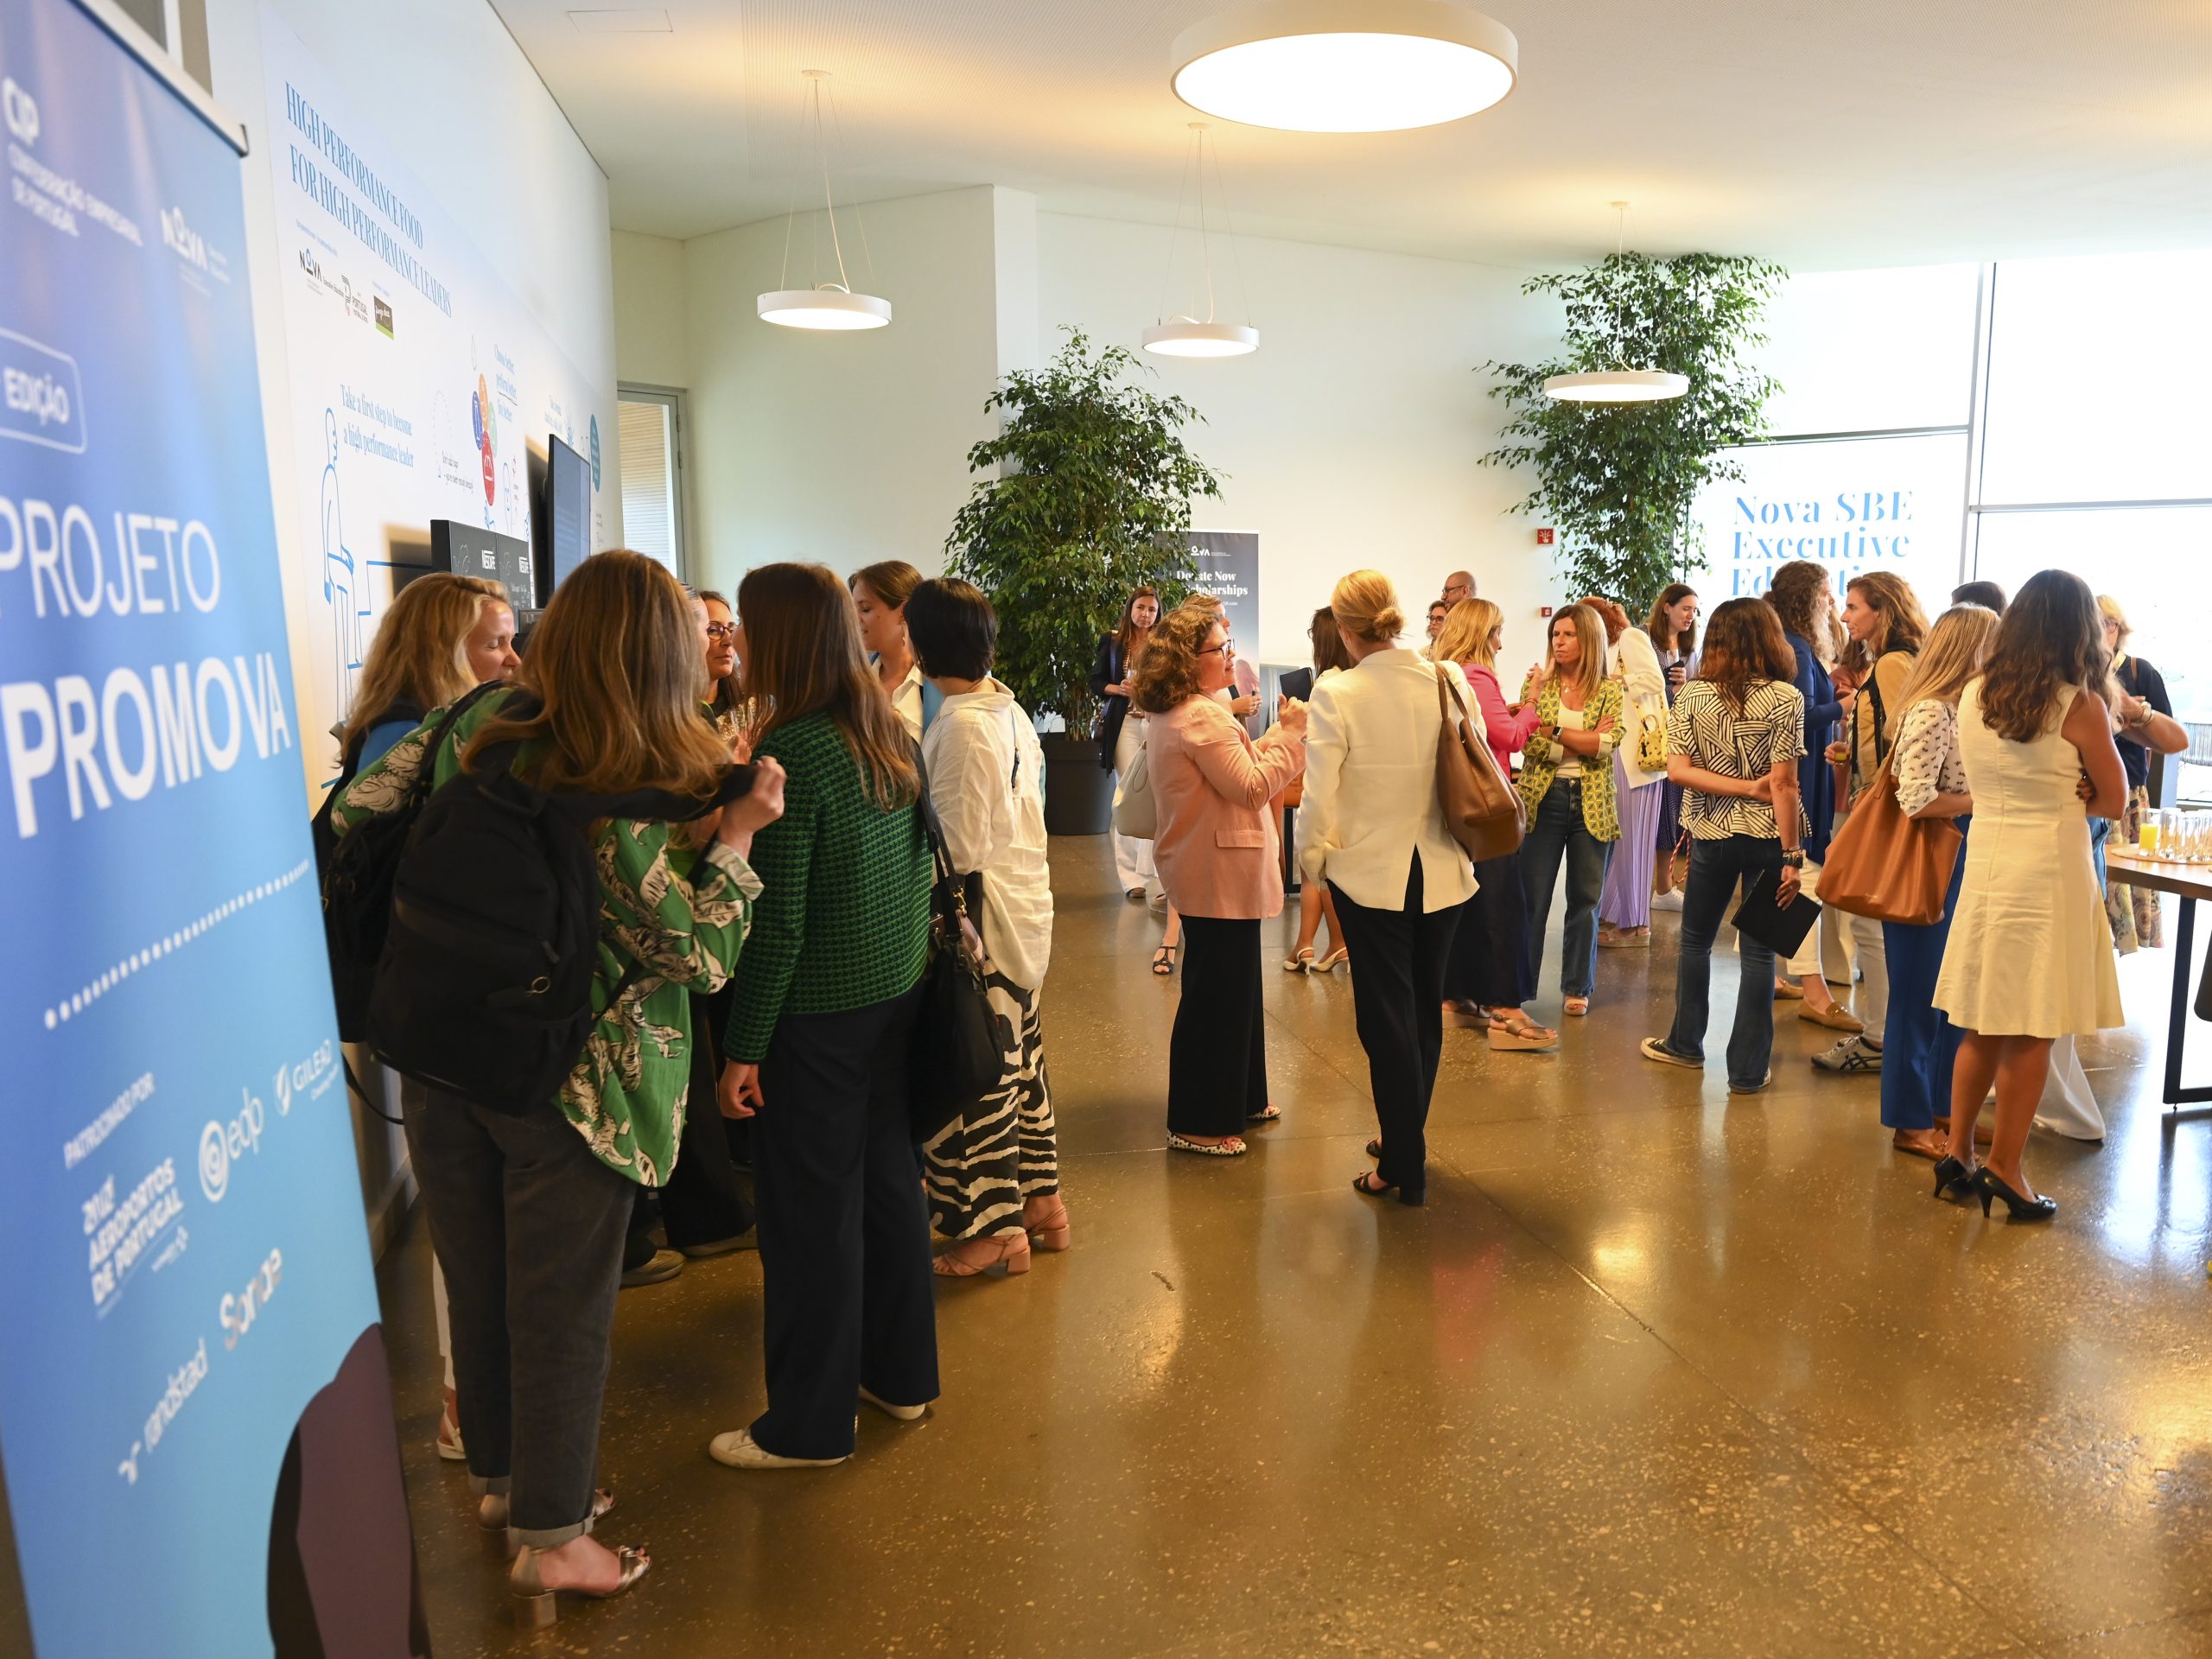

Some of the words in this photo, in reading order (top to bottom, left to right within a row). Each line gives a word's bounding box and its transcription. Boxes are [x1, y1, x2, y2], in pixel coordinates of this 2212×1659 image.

[285, 80, 321, 151] HIGH
[322, 119, 399, 228] PERFORMANCE
[398, 201, 423, 251] FOOD
[289, 143, 319, 203] FOR
[318, 170, 352, 232] HIGH
[351, 200, 421, 291] PERFORMANCE
[419, 264, 452, 319] LEADERS
[298, 247, 323, 283] NOVA
[340, 384, 357, 412] Take
[361, 392, 375, 421] first
[374, 403, 387, 429] step
[392, 408, 412, 436] become
[347, 422, 363, 454] high
[363, 432, 398, 464] performance
[397, 442, 414, 468] leader
[1734, 496, 1820, 525] Nova
[1835, 491, 1913, 522] SBE
[0, 495, 221, 619] PROJETO
[1186, 545, 1210, 556] OVA
[1733, 526, 1910, 560] Executive
[1176, 570, 1212, 582] Doate
[1214, 571, 1236, 582] Now
[0, 652, 292, 840] PROMOVA
[227, 1086, 264, 1160] edp
